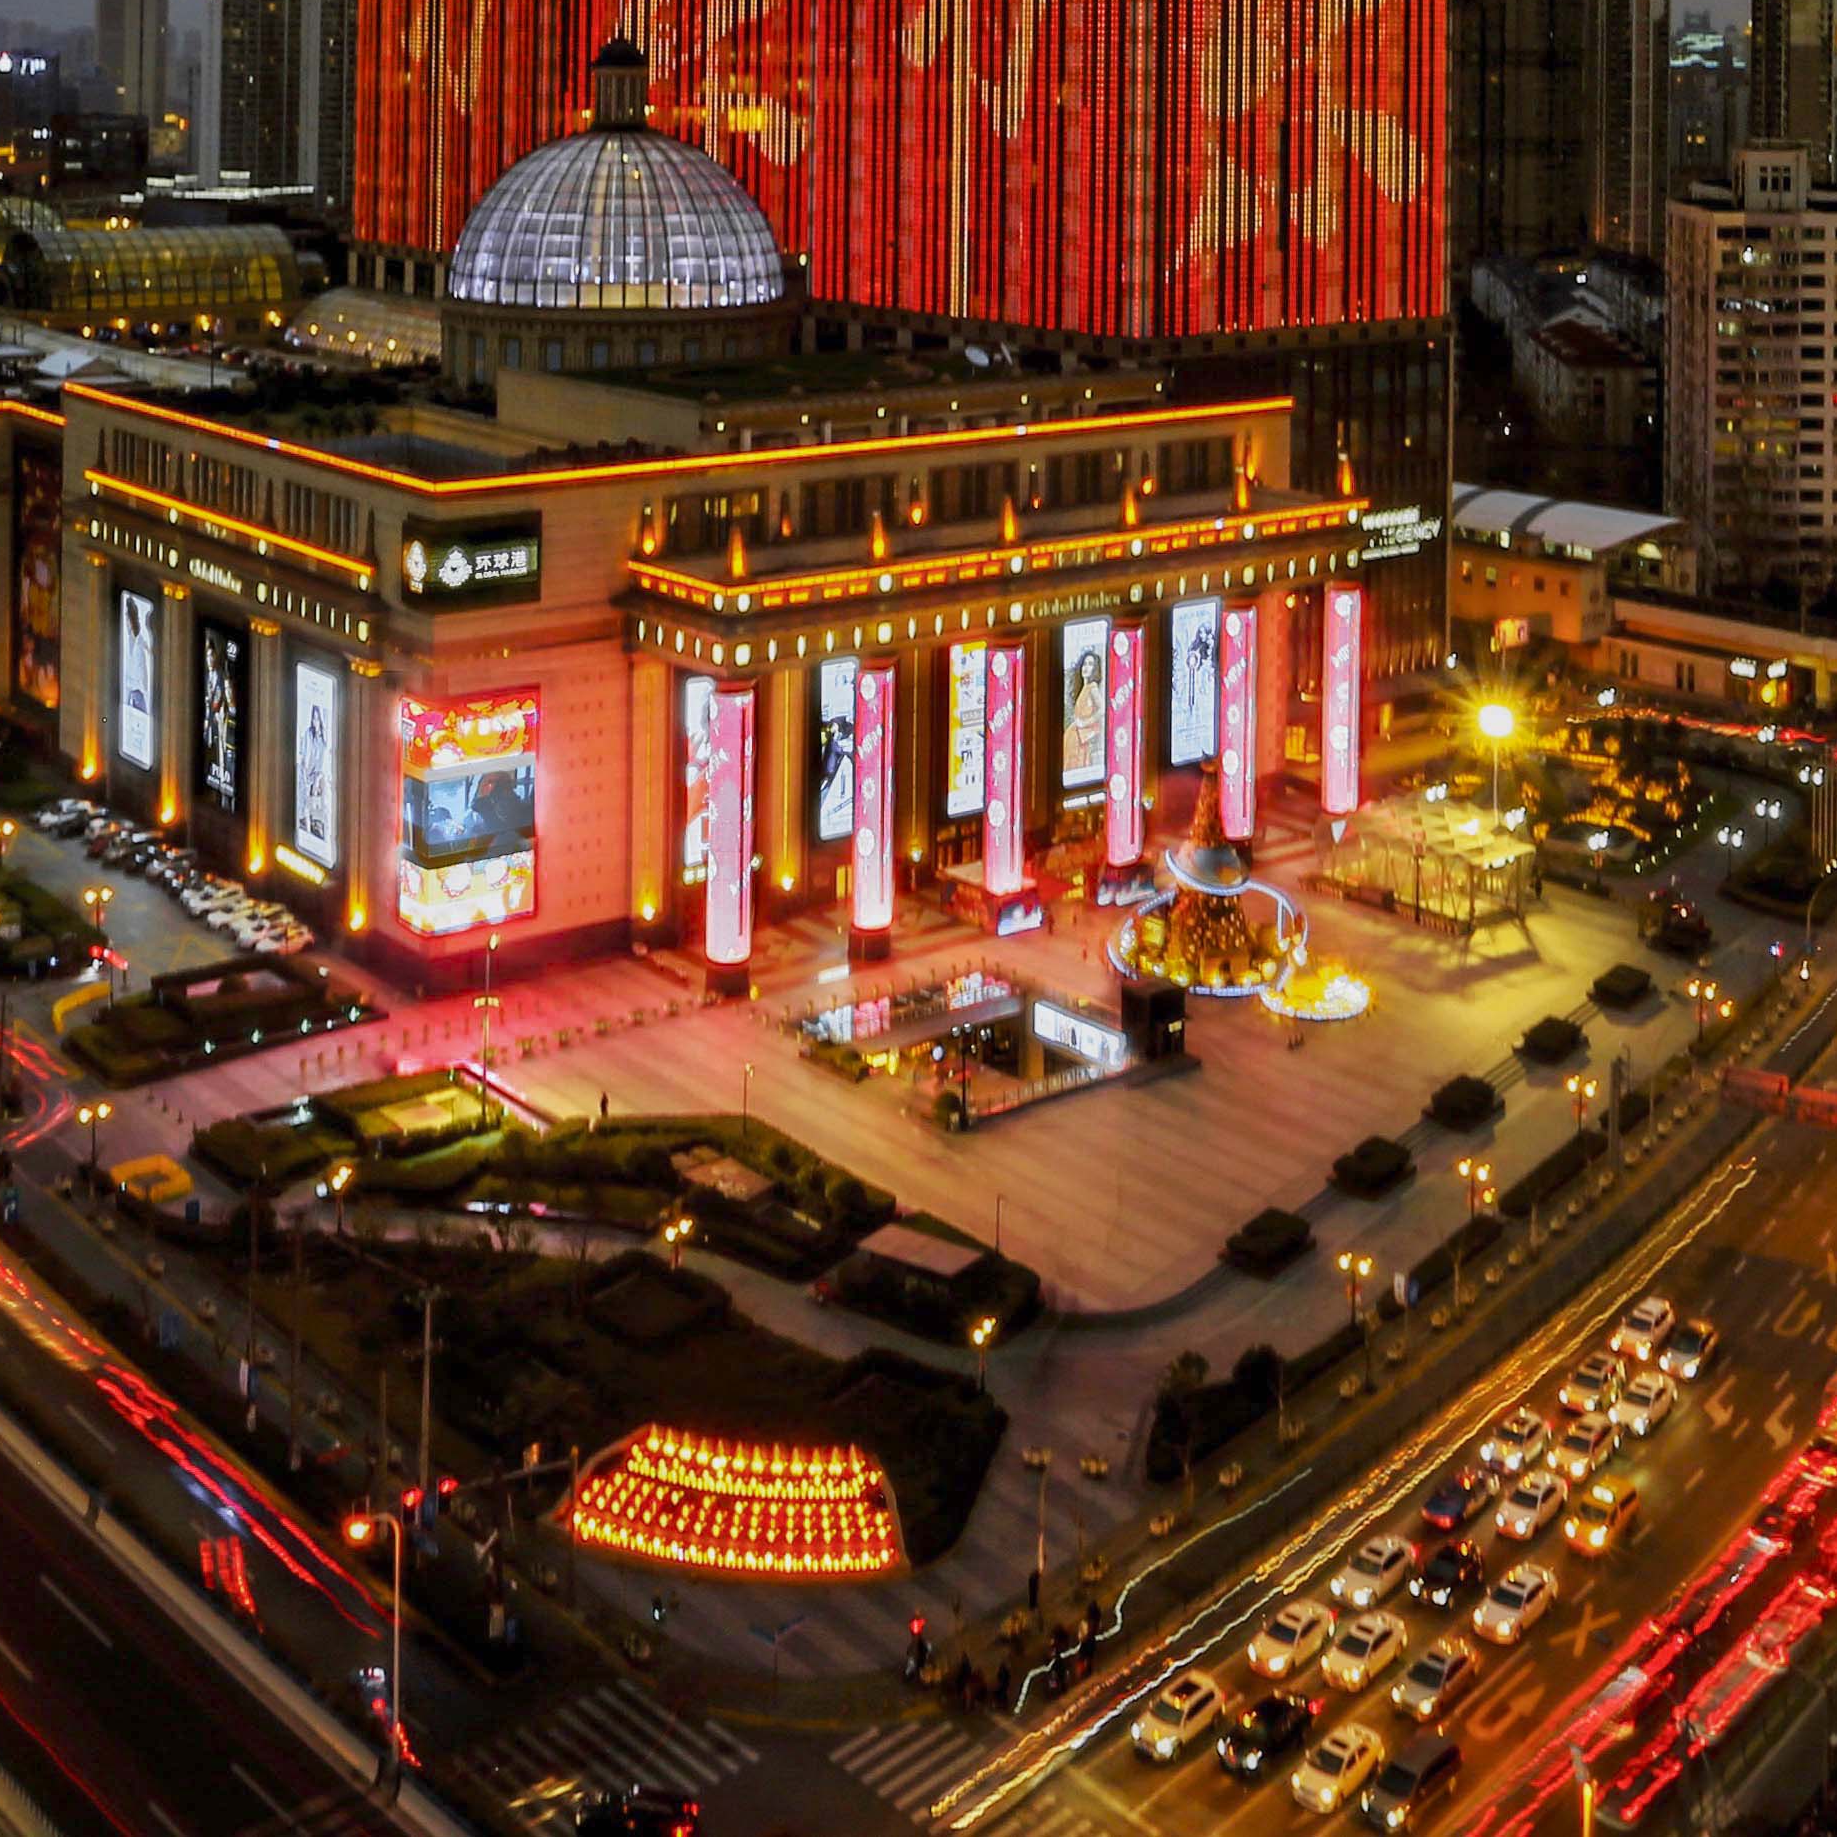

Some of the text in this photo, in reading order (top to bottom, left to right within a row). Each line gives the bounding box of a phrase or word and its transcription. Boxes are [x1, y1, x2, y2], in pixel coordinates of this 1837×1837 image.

[475, 550, 527, 571] 环球港
[1030, 595, 1074, 619] Global
